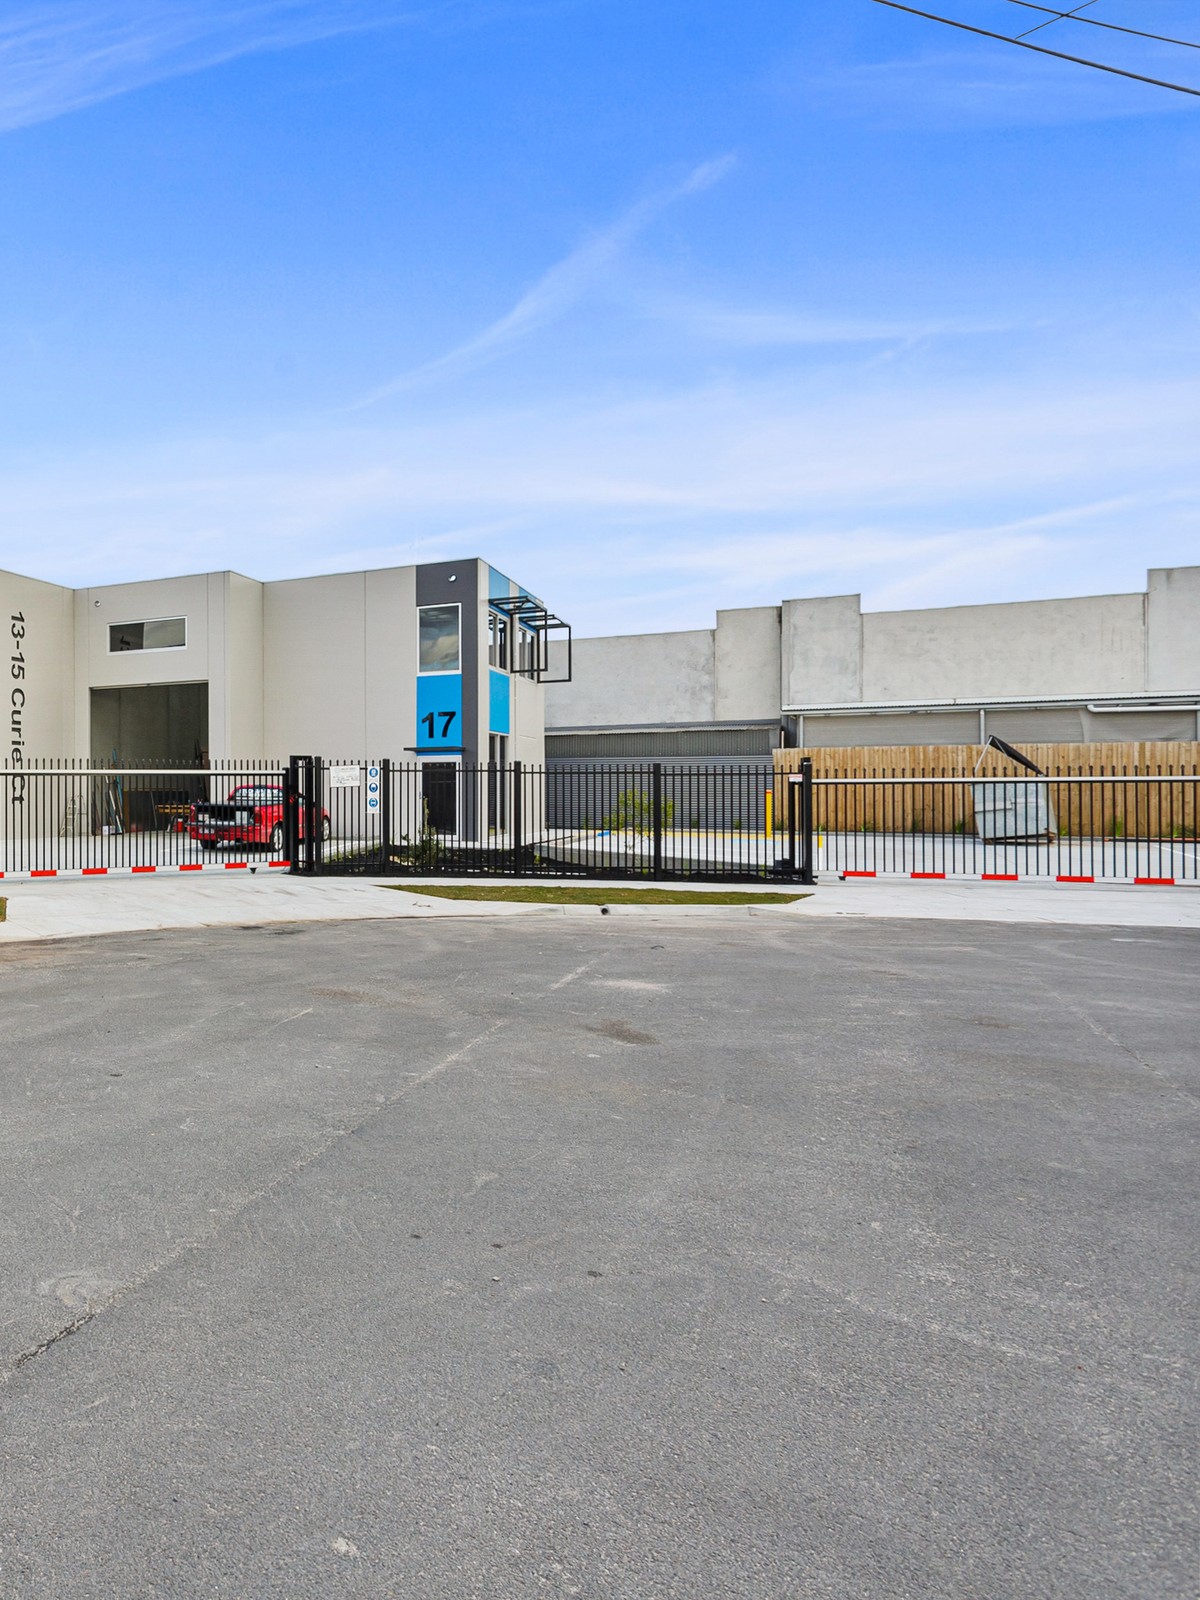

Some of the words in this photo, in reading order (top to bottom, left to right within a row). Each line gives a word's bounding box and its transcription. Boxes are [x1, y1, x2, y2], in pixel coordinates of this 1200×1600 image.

[11, 611, 25, 680] 13-15
[11, 688, 25, 763] Curie
[421, 711, 456, 739] 17
